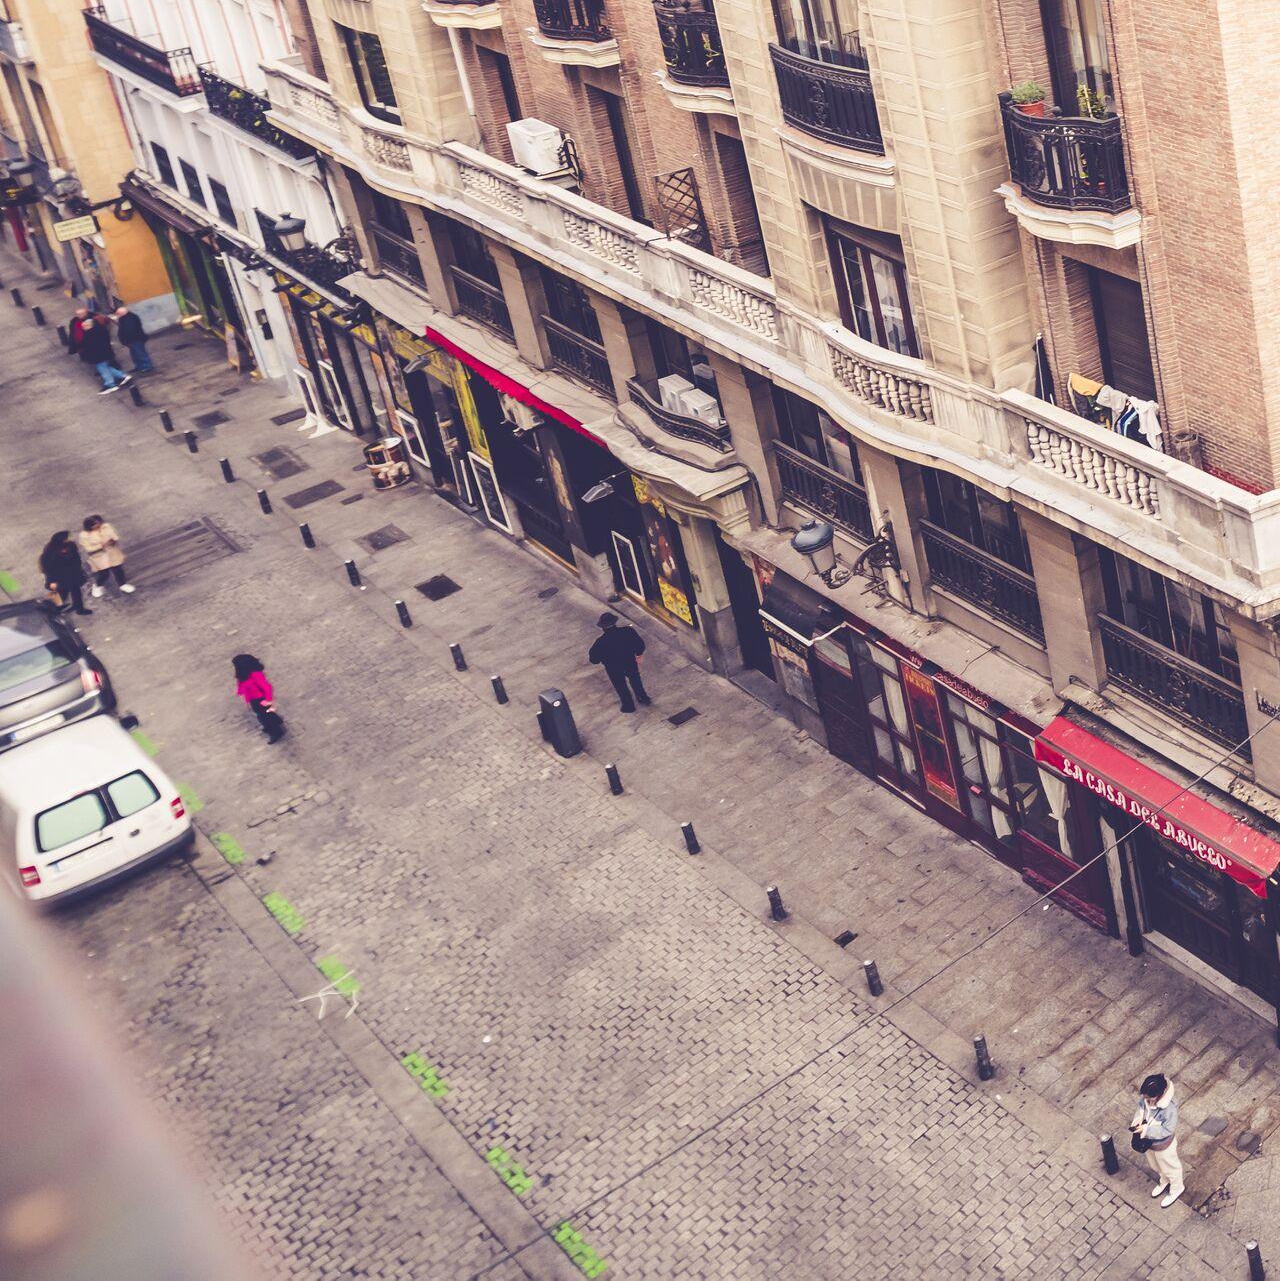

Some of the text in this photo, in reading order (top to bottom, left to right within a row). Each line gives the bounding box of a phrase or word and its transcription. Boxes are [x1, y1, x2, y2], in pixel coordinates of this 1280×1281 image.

[1063, 758, 1227, 870] LA CASA DEL ABUELO
